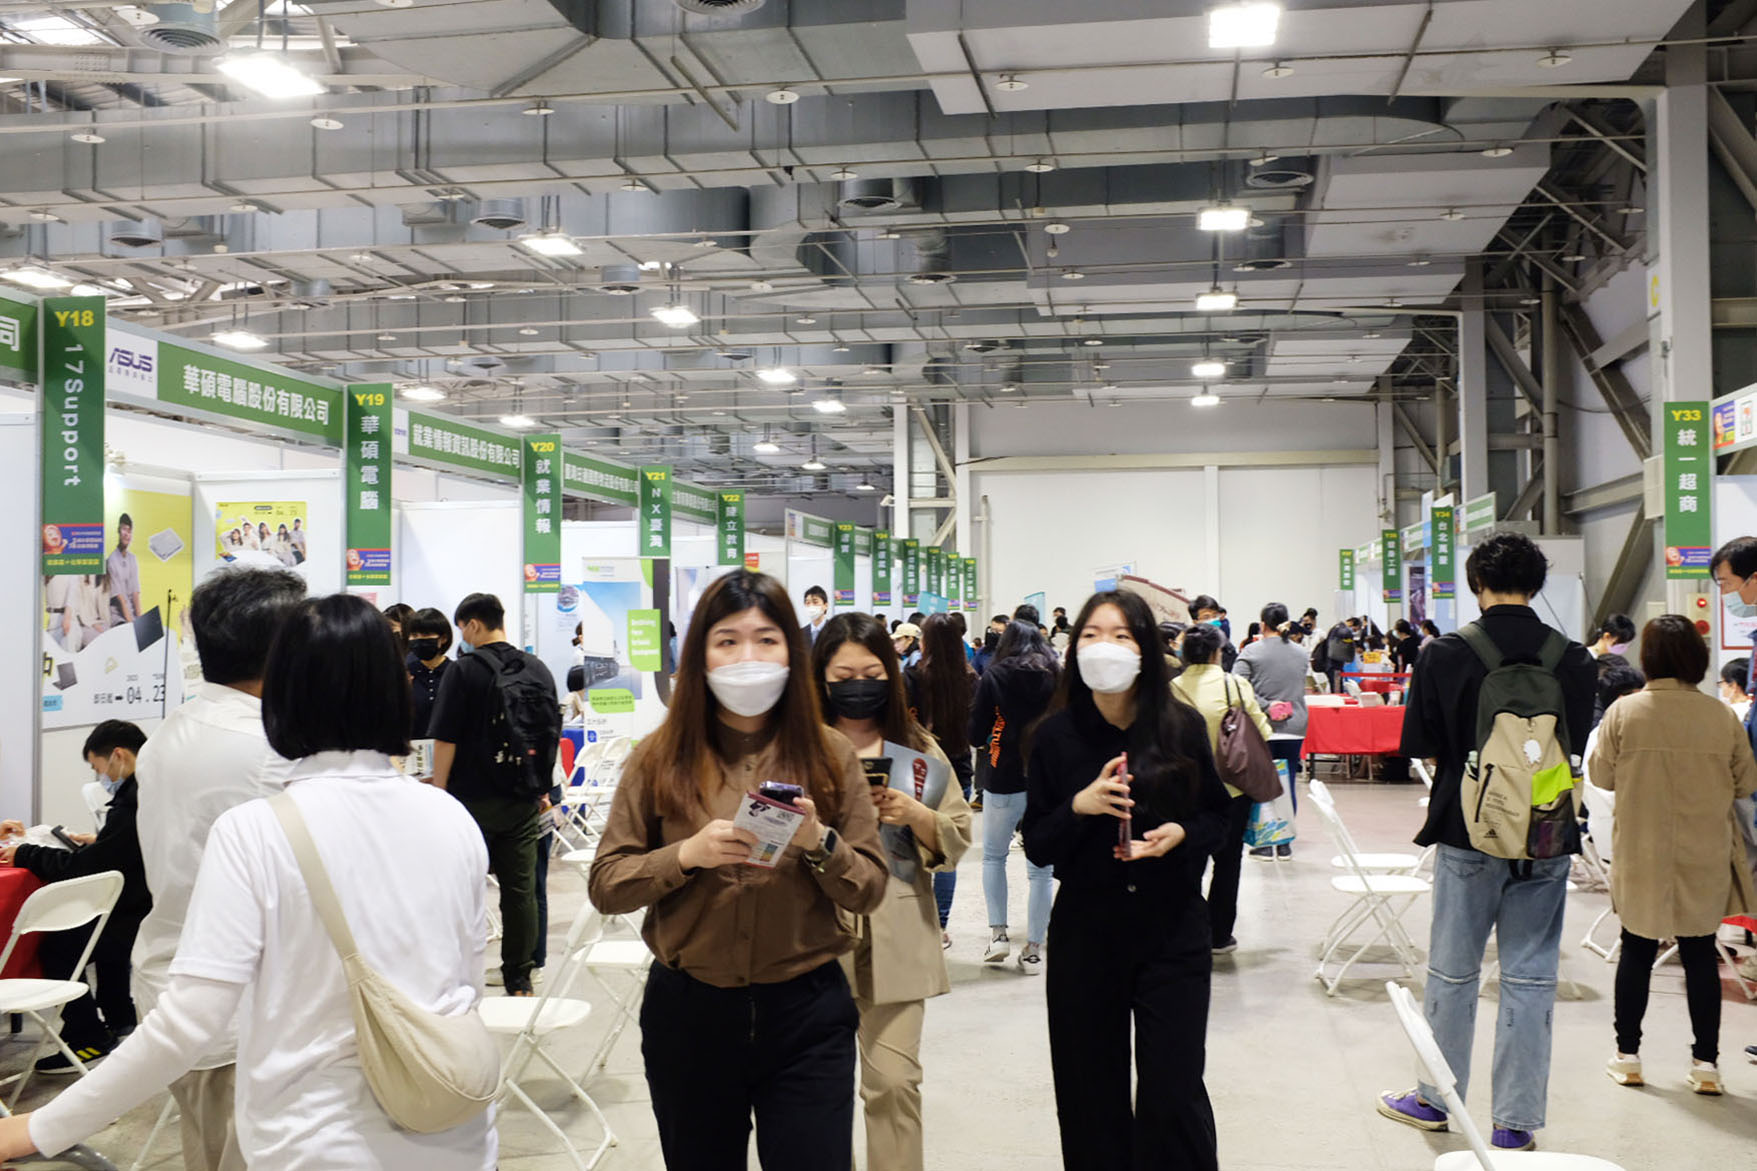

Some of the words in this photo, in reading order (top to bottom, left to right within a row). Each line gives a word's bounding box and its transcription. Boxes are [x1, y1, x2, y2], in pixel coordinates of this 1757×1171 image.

[55, 310, 95, 327] Y18
[109, 347, 153, 373] ASUS
[184, 363, 329, 426] 華碩電腦股份有限公司
[355, 393, 385, 407] Y19
[61, 343, 84, 487] 17Support
[1671, 409, 1702, 421] Y33
[530, 442, 556, 452] Y20
[360, 414, 380, 510] 華碩電腦
[1677, 428, 1698, 513] 統一超商
[645, 471, 666, 480] Y21
[535, 458, 552, 534] 就業情報
[721, 494, 741, 503] Y22
